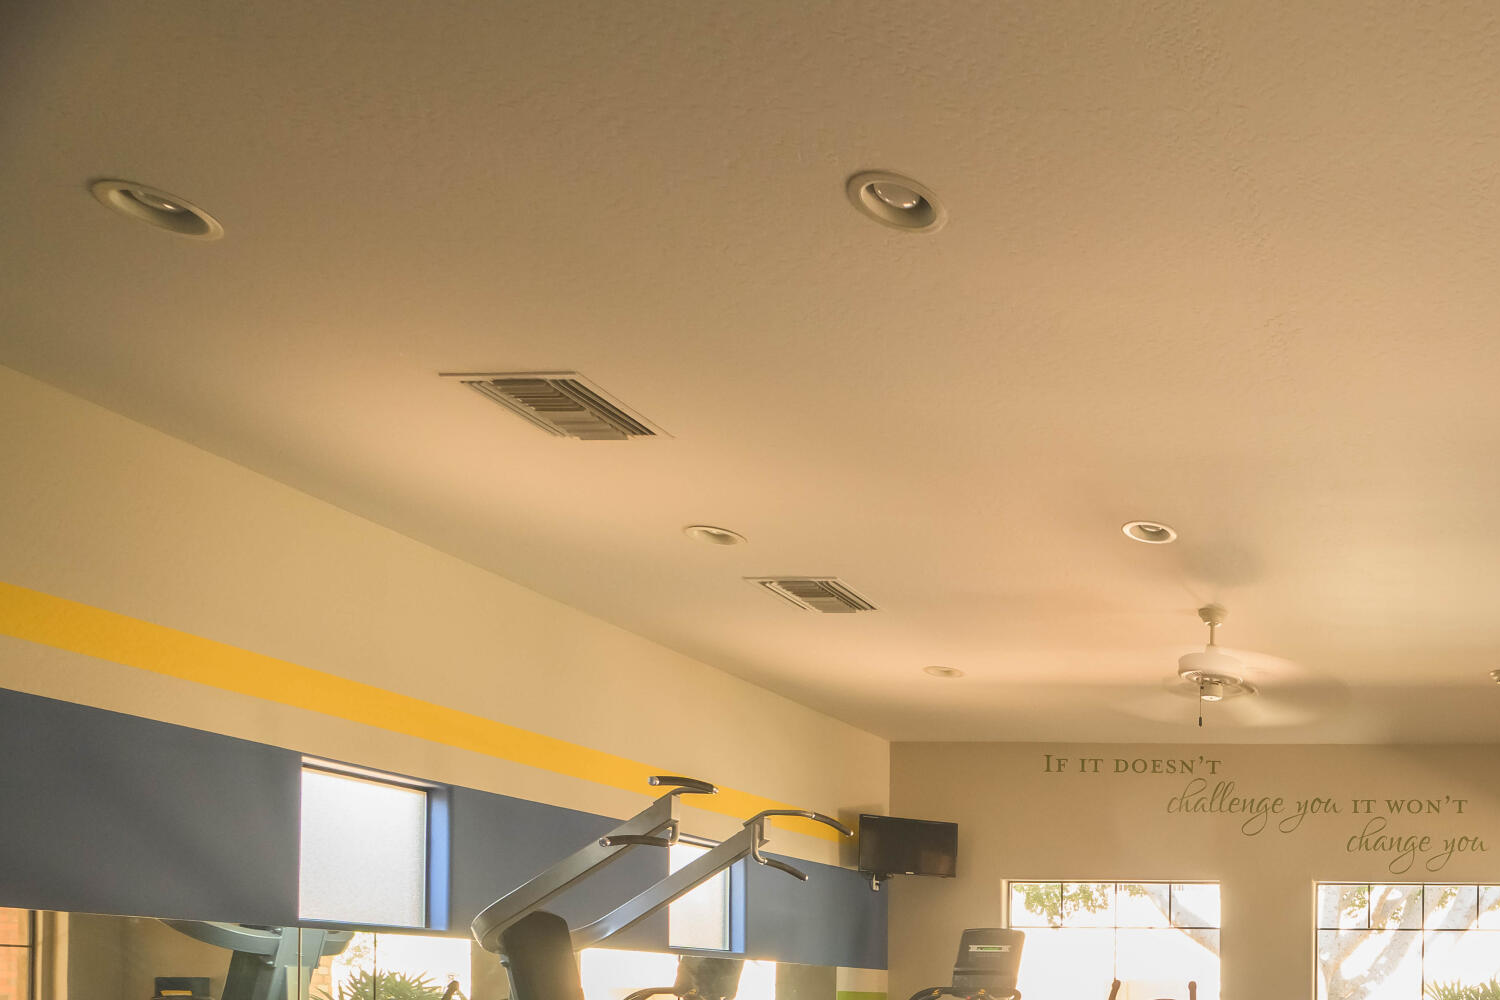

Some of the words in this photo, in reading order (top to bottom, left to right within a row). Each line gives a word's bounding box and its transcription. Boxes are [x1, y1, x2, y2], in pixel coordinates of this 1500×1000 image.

[1079, 758, 1104, 773] IT
[1166, 777, 1284, 837] challenge
[1278, 797, 1342, 834] you
[1351, 799, 1377, 814] IT
[1386, 795, 1469, 814] WON'T
[1346, 816, 1432, 875] change
[1425, 835, 1488, 873] you
